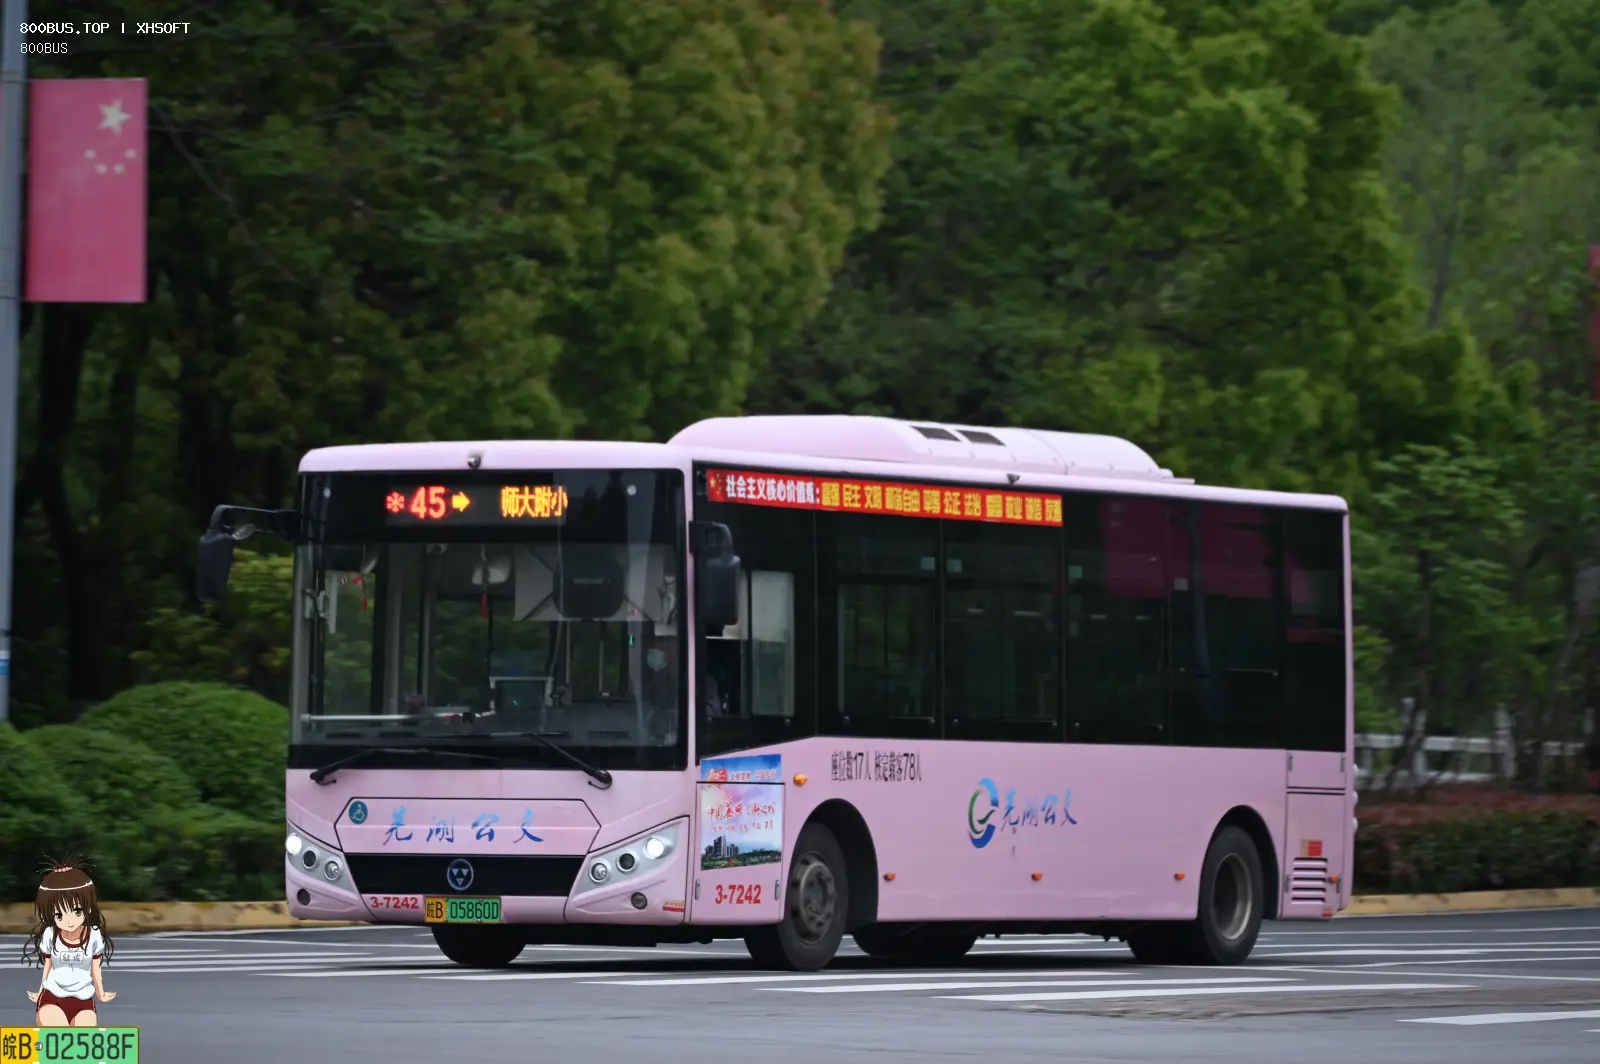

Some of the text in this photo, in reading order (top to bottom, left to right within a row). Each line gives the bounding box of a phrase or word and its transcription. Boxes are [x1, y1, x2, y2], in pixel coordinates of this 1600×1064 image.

[410, 486, 568, 519] 45 师大附小
[370, 896, 420, 910] 3-7242
[715, 884, 761, 905] 3-7242
